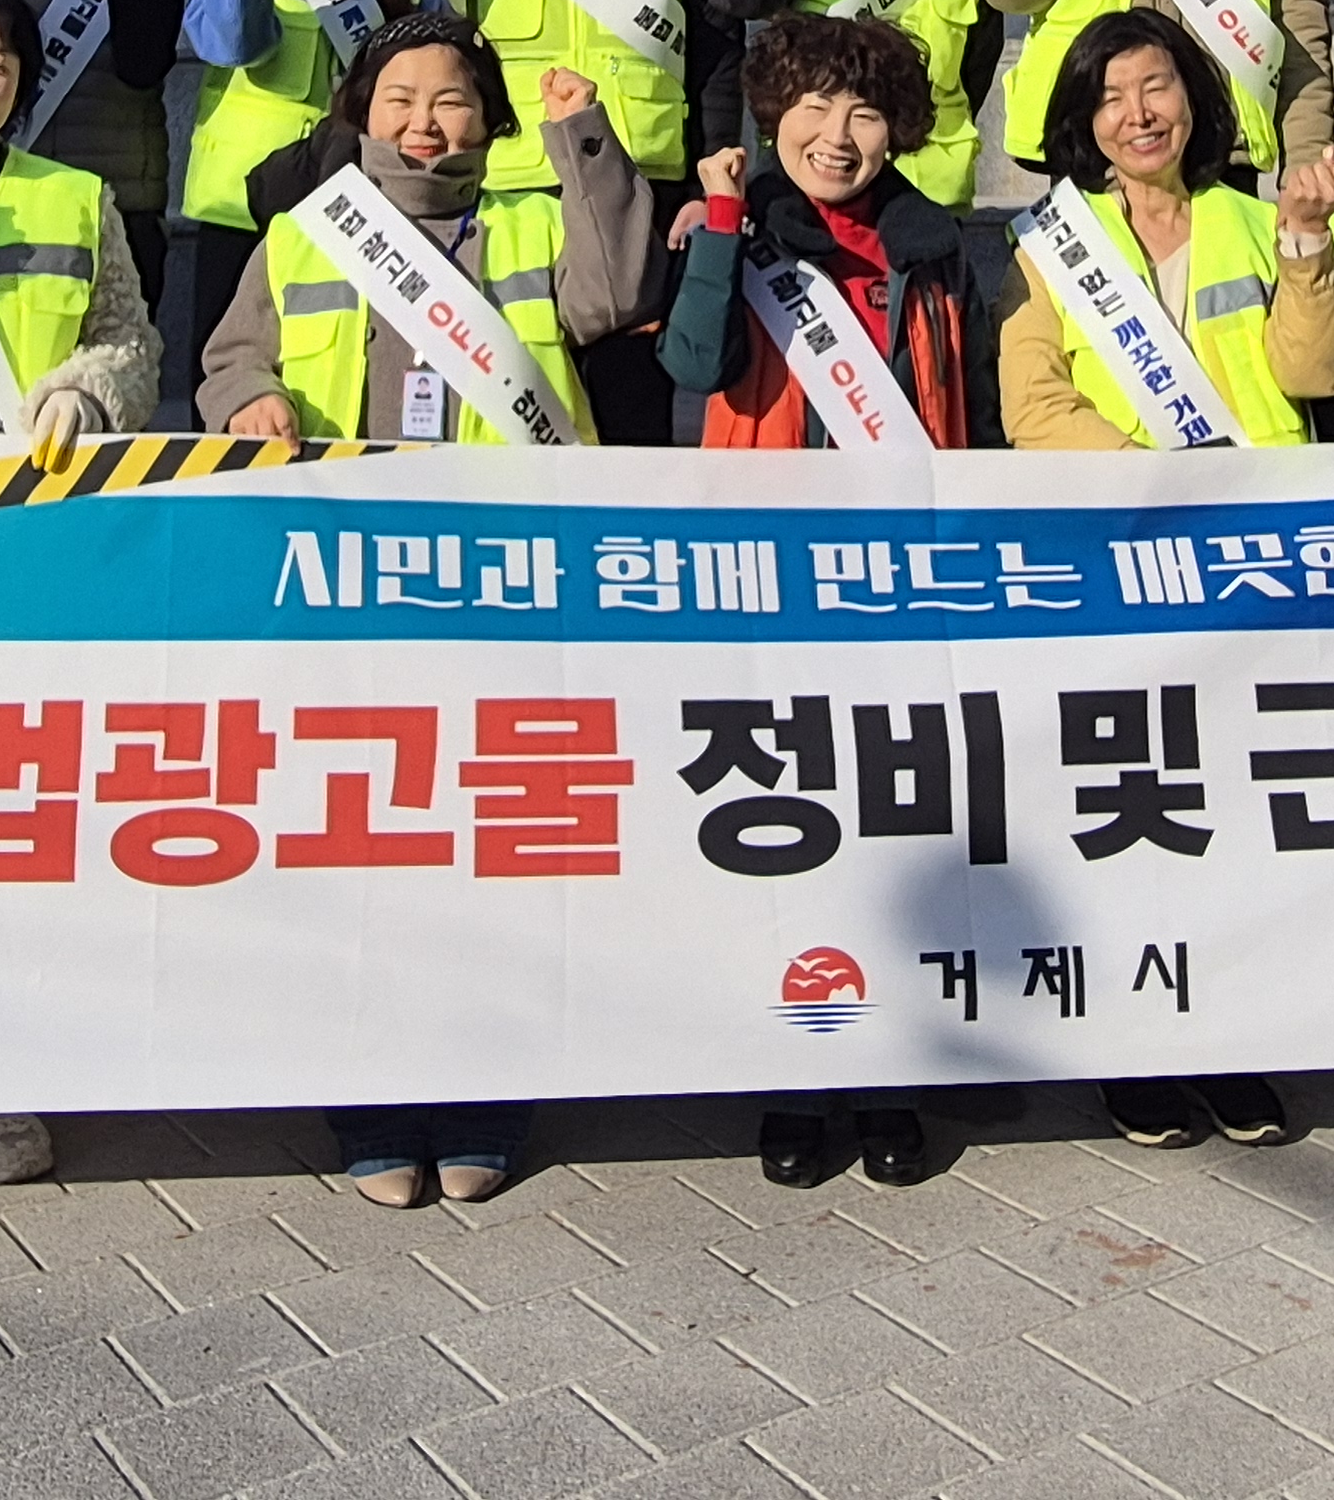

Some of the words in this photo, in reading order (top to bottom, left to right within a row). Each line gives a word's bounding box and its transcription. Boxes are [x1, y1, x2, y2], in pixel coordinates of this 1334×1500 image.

[1218, 9, 1265, 65] OFF
[323, 192, 367, 239] 불법
[358, 230, 431, 304] 광고물
[427, 301, 494, 375] OFF
[767, 270, 839, 356] 광고물
[830, 359, 884, 442] OFF
[1077, 266, 1126, 318] 없는
[1111, 315, 1177, 396] 깨끗한
[1164, 393, 1213, 447] 거제
[273, 530, 565, 611] 시민과
[594, 536, 781, 614] 함께
[808, 540, 1083, 614] 만드는
[678, 692, 1008, 877] 정비
[1058, 684, 1214, 861] 및
